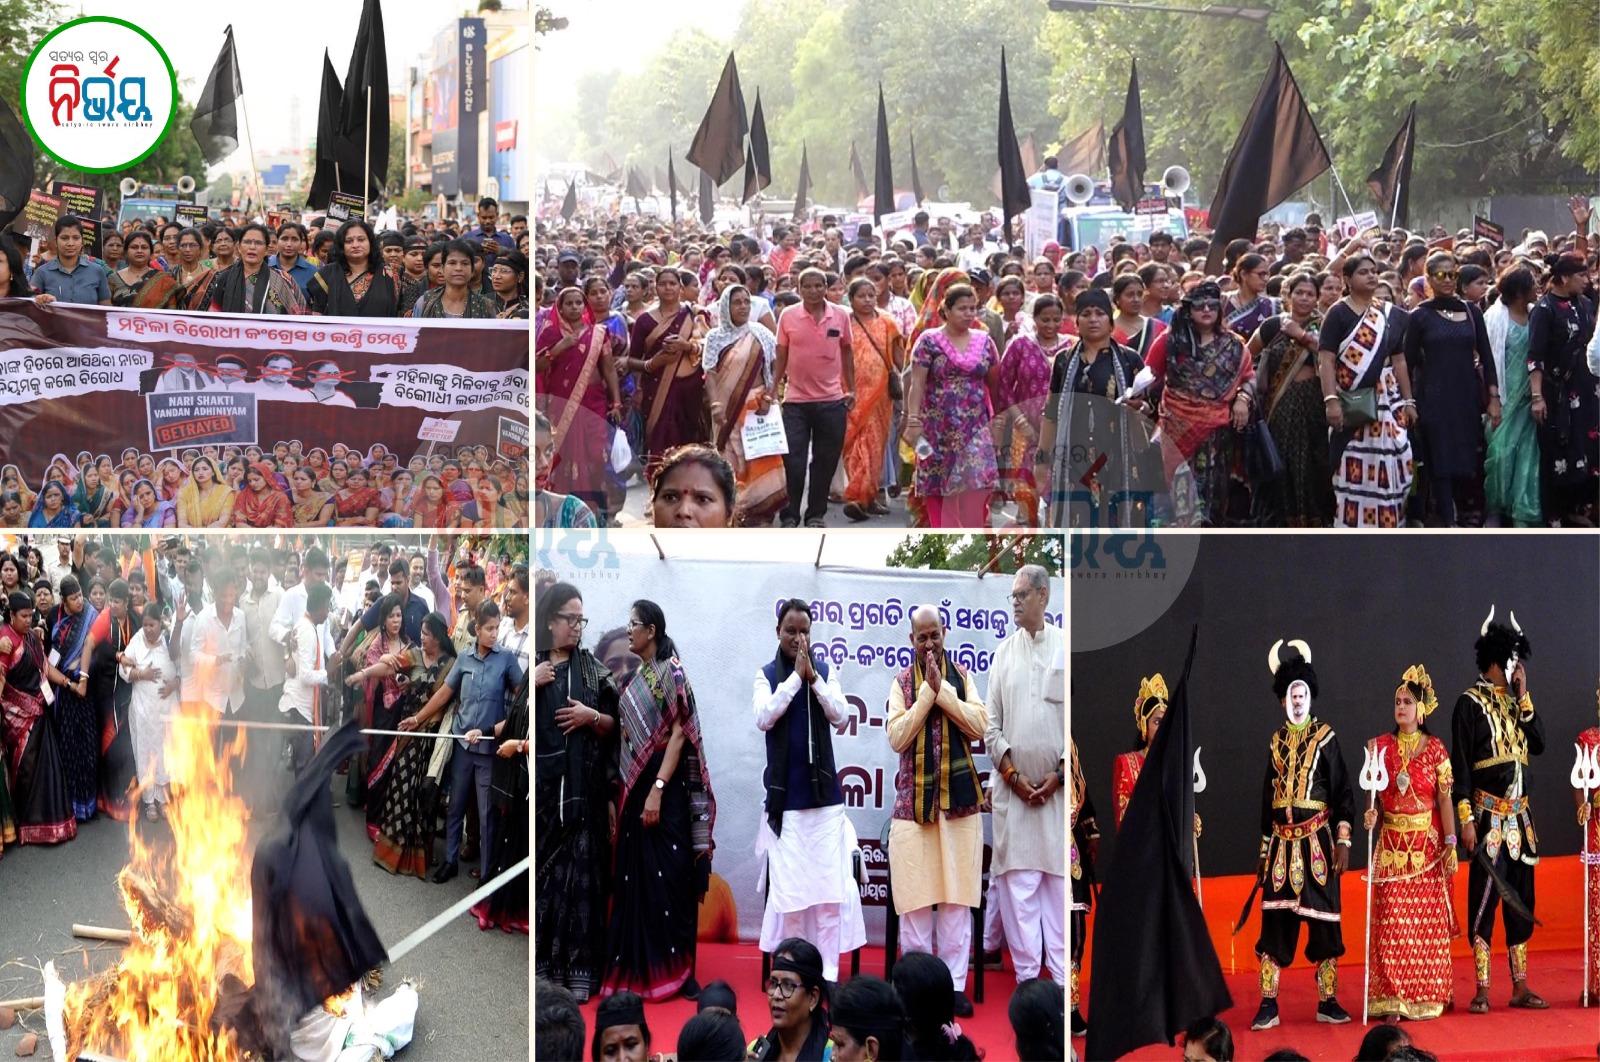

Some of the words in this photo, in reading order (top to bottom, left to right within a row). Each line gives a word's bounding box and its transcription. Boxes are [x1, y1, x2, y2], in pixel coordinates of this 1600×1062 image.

[464, 43, 473, 112] BLUESTONE
[118, 316, 169, 335] ମହିଳା
[173, 320, 240, 340] ବିରୋଧୀ
[245, 327, 308, 345] କଂଗ୍ରେସ
[312, 331, 326, 343] ଓ
[23, 355, 64, 374] ହିତରେ
[67, 353, 116, 368] ଆସିଥିବା
[118, 353, 147, 367] ନାରୀ
[44, 373, 76, 389] କଲେ
[79, 369, 123, 385] ବିରୋଧ
[451, 373, 500, 392] ମିଳିବାକୁ
[168, 395, 194, 407] NARI
[196, 395, 234, 406] SHAKTI
[153, 407, 191, 419] VANDAN
[193, 406, 247, 416] ADHINIYAM
[160, 418, 230, 442] BETRAYED
[848, 598, 903, 630] ପ୍ରଗତି
